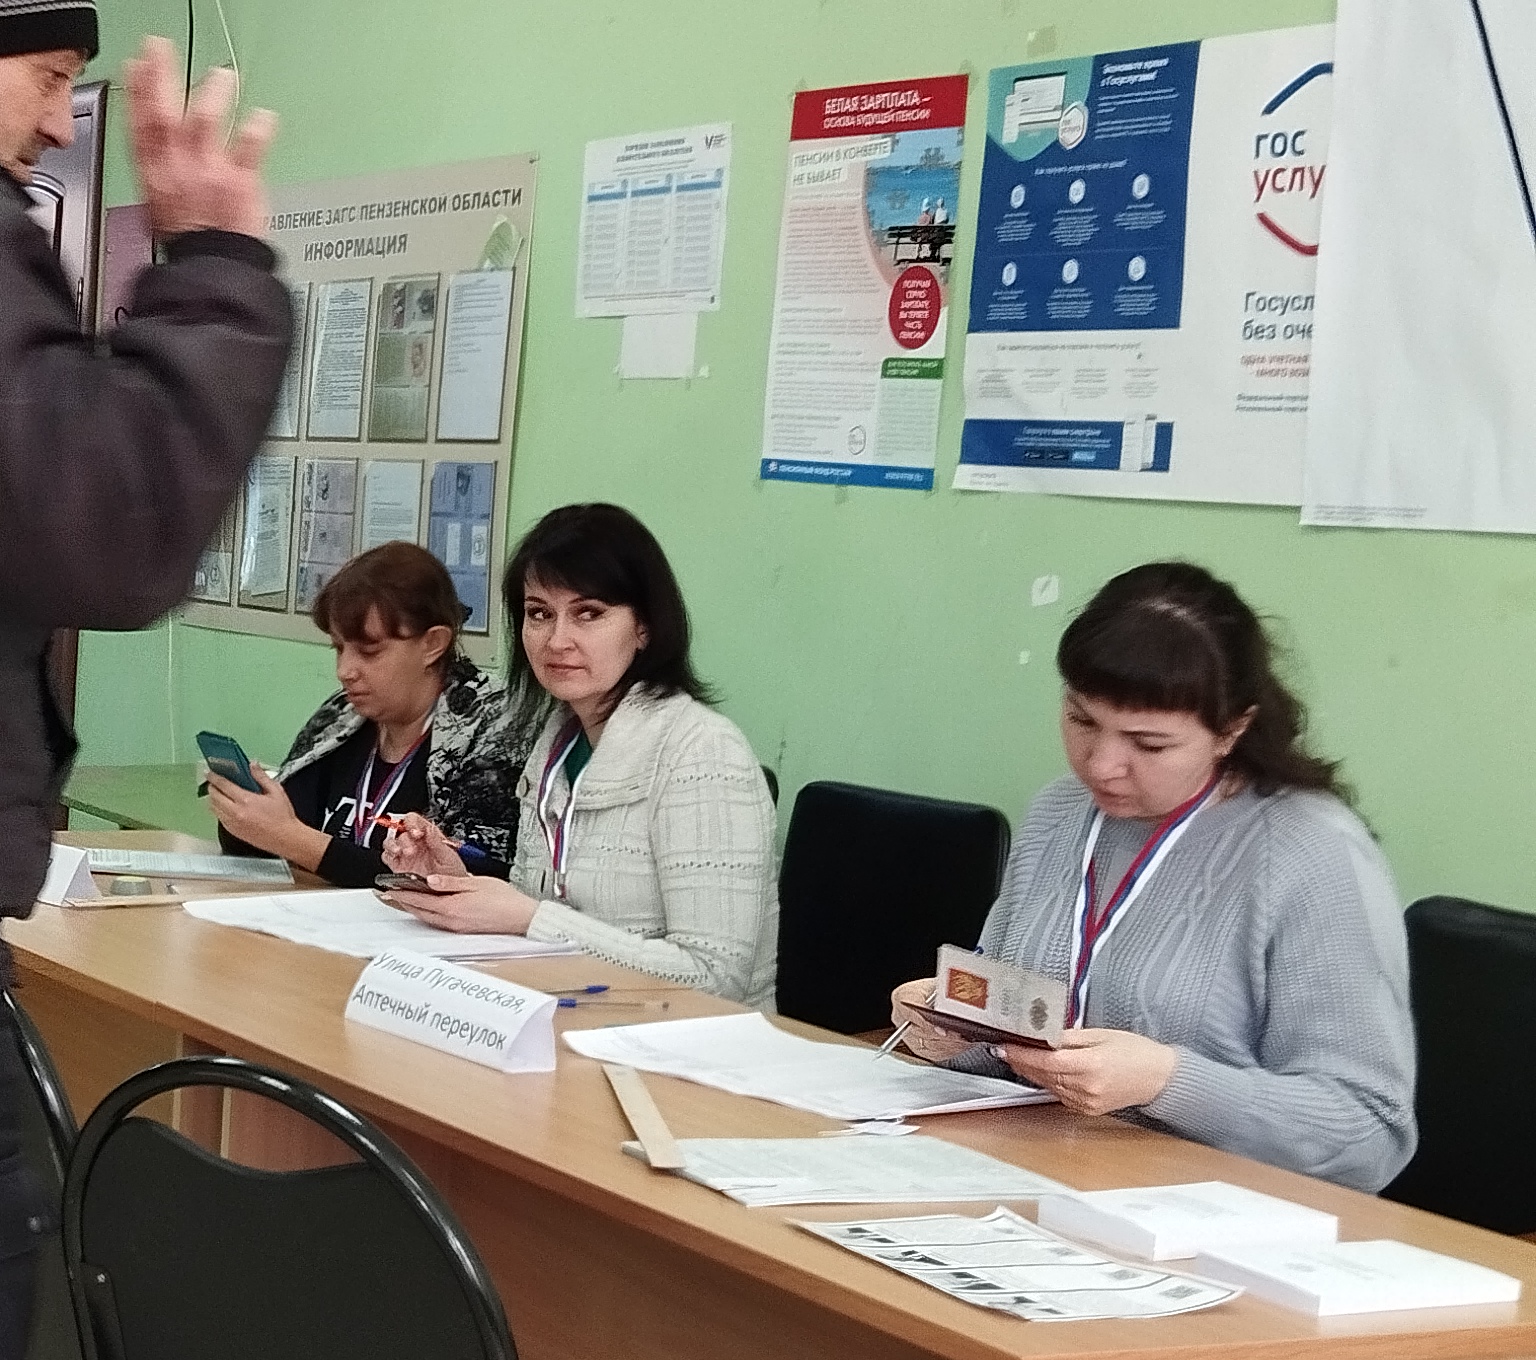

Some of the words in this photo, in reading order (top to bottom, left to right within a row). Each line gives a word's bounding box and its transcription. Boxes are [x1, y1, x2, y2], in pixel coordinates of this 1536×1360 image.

[825, 95, 859, 115] БЕЛАЯ
[860, 90, 920, 112] ЗАРПЛАТА
[793, 151, 834, 167] ПЕНСИИ
[843, 142, 889, 160] КОНВЕРТЕ
[793, 173, 805, 186] НЕ
[807, 167, 842, 184] БЫВАЕТ
[1253, 165, 1326, 203] услу
[263, 209, 322, 231] РАВЛЕНИЕ
[325, 206, 356, 226] ЗАГС
[360, 194, 447, 221] ПЕНЗЕНСКОЙ
[452, 188, 523, 211] ОБЛАСТИ
[304, 234, 408, 261] ИНФОРМАЦИЯ
[1244, 291, 1314, 316] Госусл
[1242, 319, 1276, 340] без
[1283, 323, 1313, 340] оче
[373, 952, 424, 979] Улица
[423, 968, 525, 1015] Пугачевская,
[353, 984, 431, 1024] Аптечный
[430, 1012, 508, 1051] переулок
